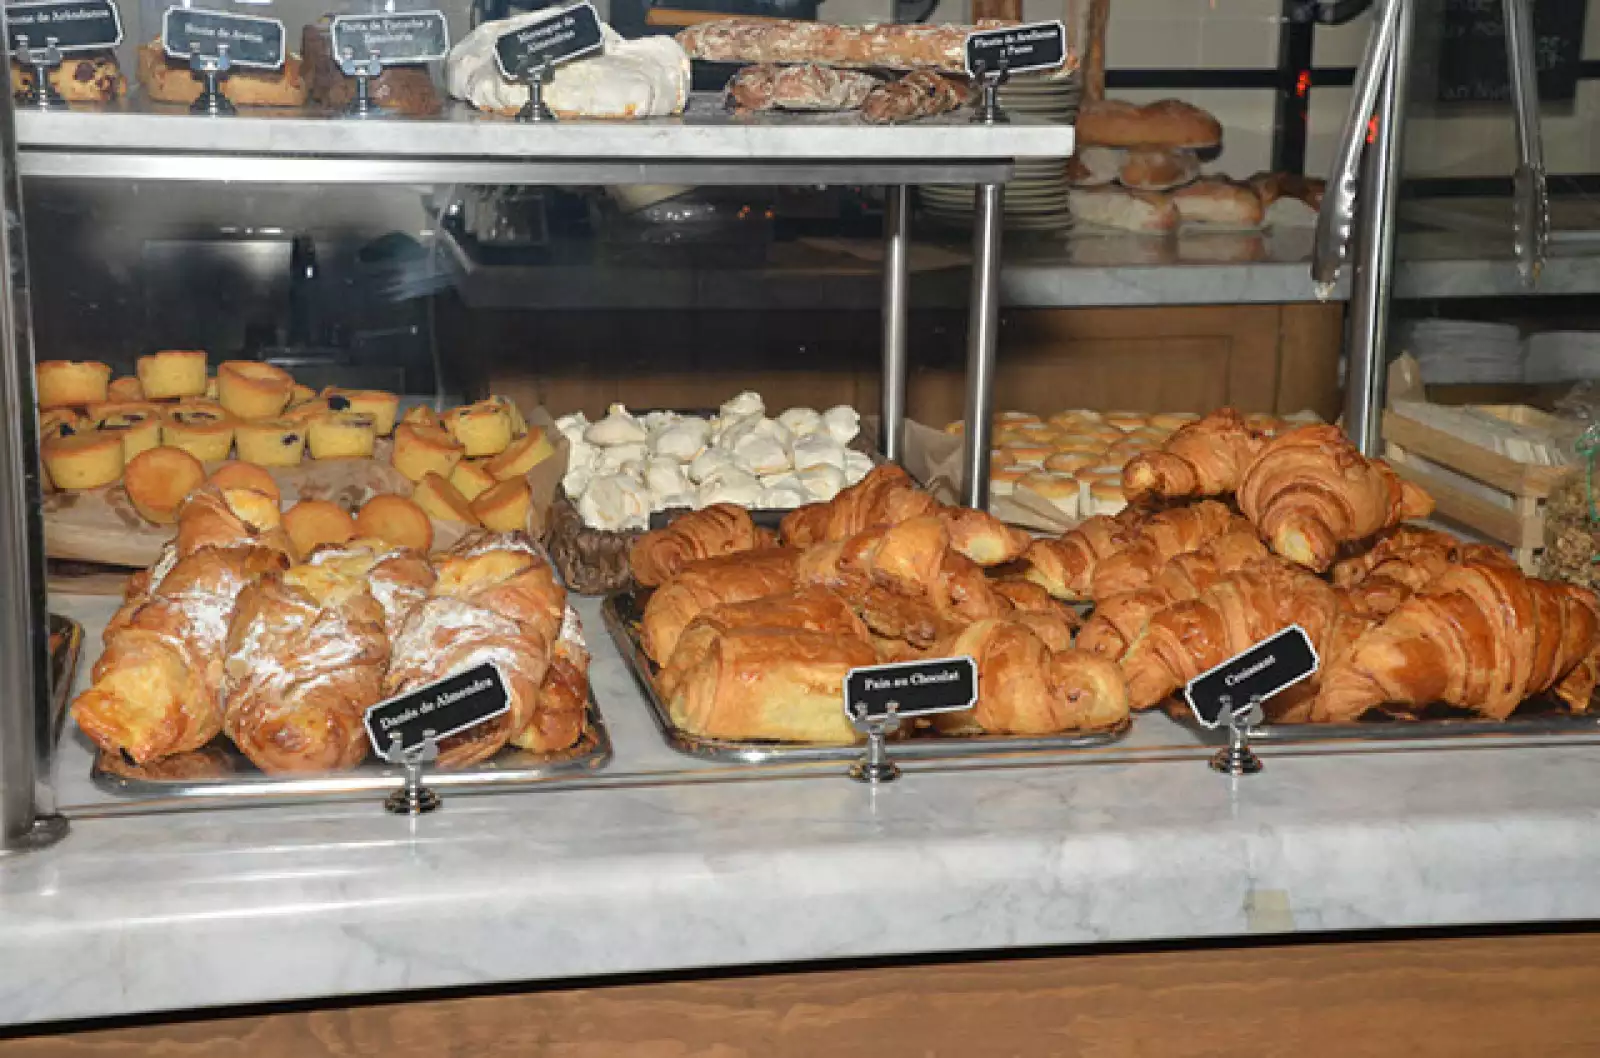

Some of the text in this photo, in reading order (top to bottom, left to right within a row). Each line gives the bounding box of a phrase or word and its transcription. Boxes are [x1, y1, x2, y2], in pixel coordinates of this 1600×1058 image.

[864, 677, 891, 691] Pain
[909, 669, 960, 687] Chocolat
[420, 701, 436, 714] de
